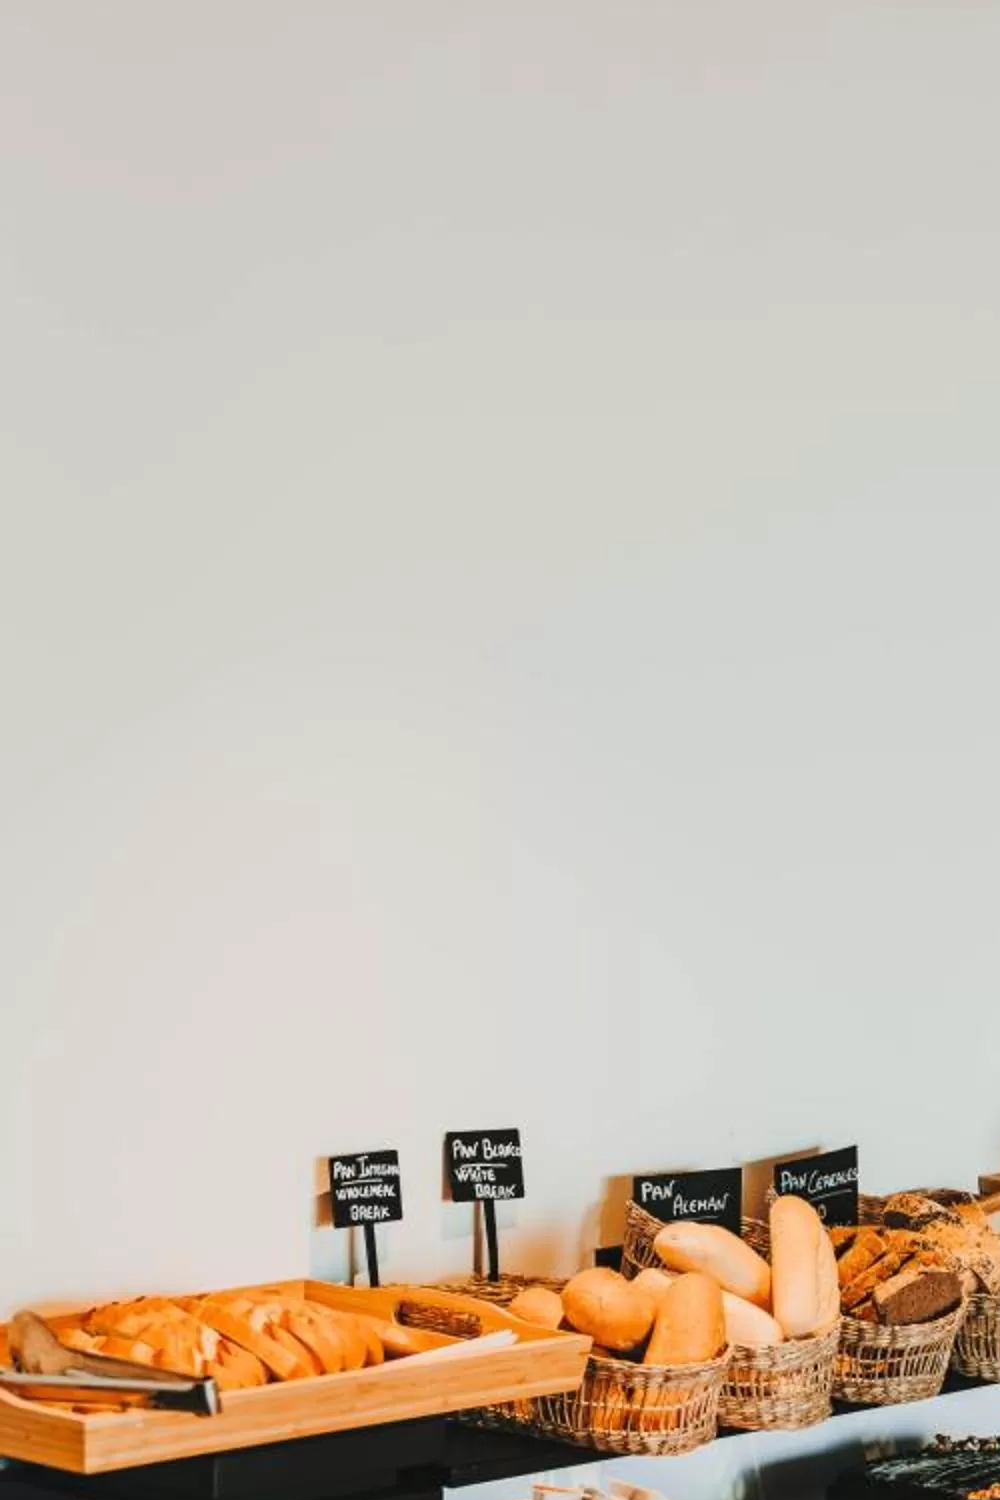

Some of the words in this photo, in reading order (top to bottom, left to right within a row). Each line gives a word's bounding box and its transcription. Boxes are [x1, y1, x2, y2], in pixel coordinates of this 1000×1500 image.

[452, 1139, 479, 1160] PAN
[333, 1160, 356, 1180] PAN
[641, 1179, 676, 1203] PAN
[781, 1171, 807, 1193] PAN
[673, 1191, 730, 1217] ALEMAN
